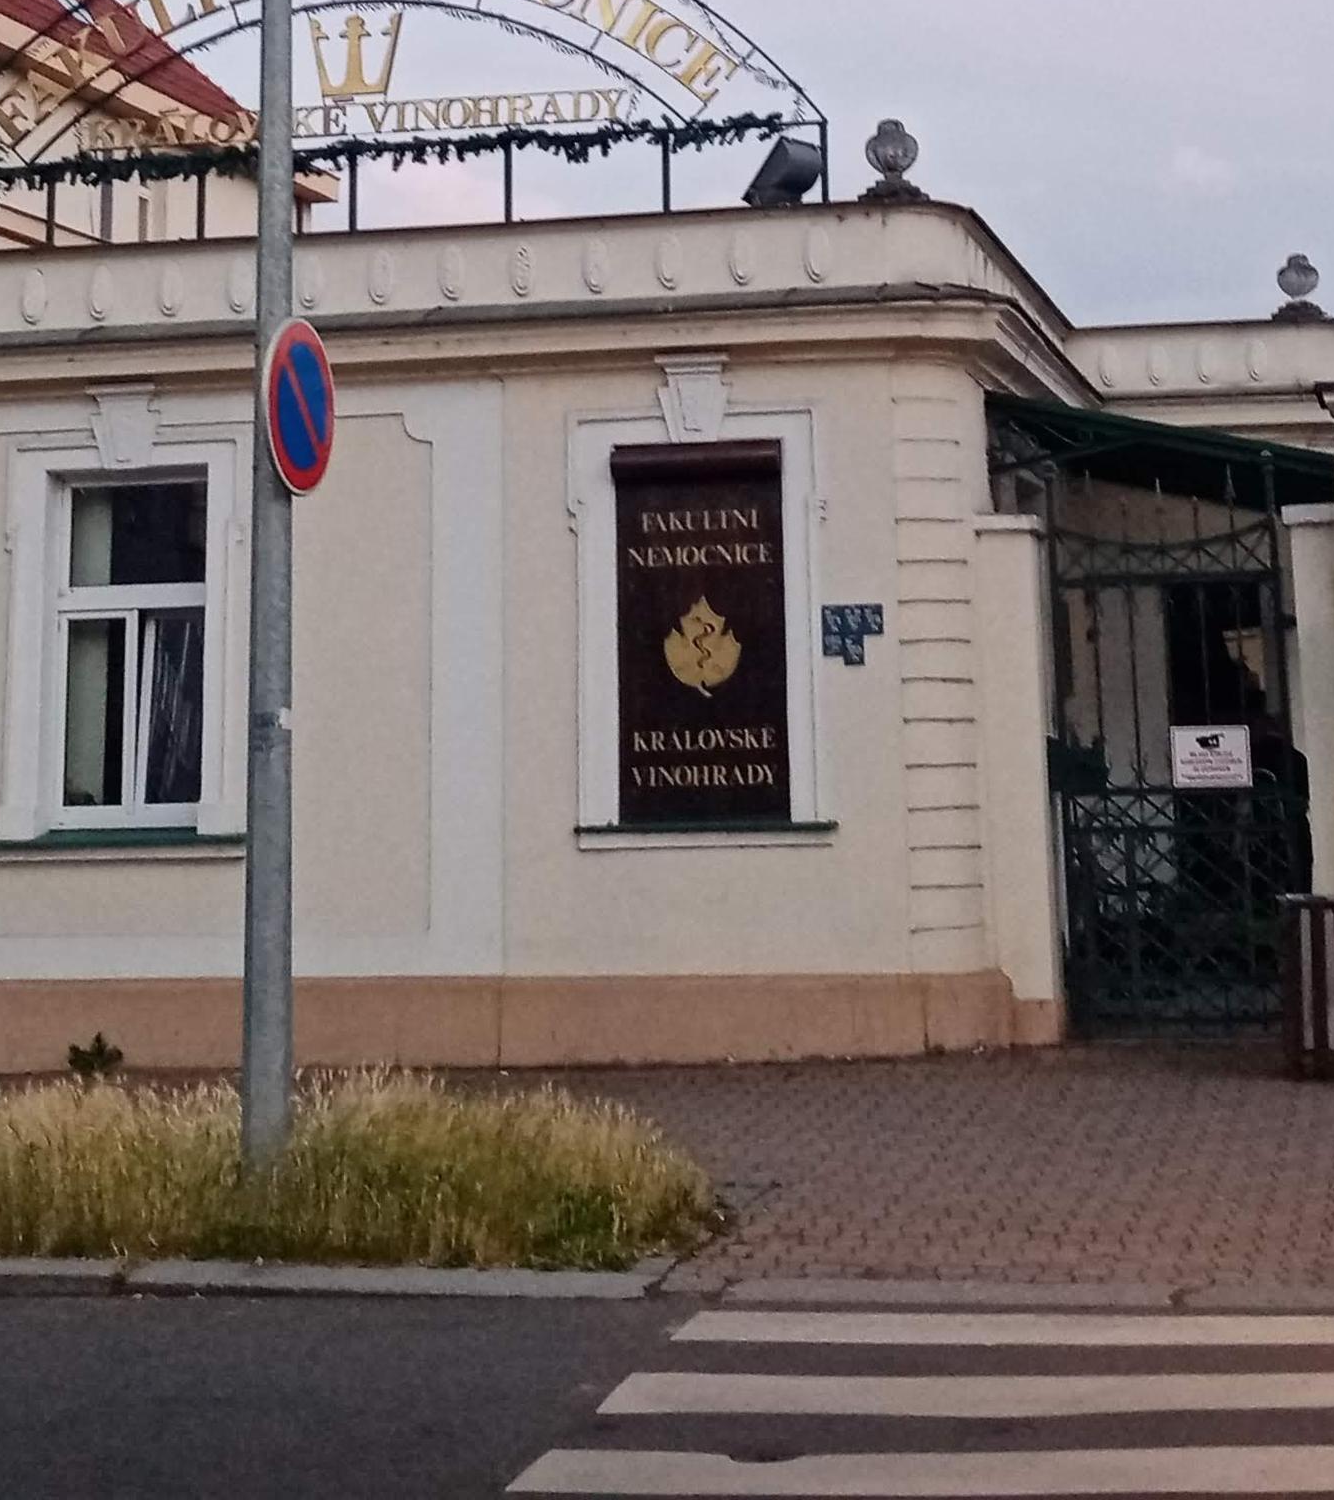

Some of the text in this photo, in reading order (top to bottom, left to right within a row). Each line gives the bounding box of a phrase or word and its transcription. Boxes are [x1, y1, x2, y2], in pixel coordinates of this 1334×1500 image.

[85, 89, 626, 147] KRÁLOVKÉ VINOHRADY
[627, 542, 774, 568] NEMOCNICE
[631, 763, 777, 788] VINOHRADY
